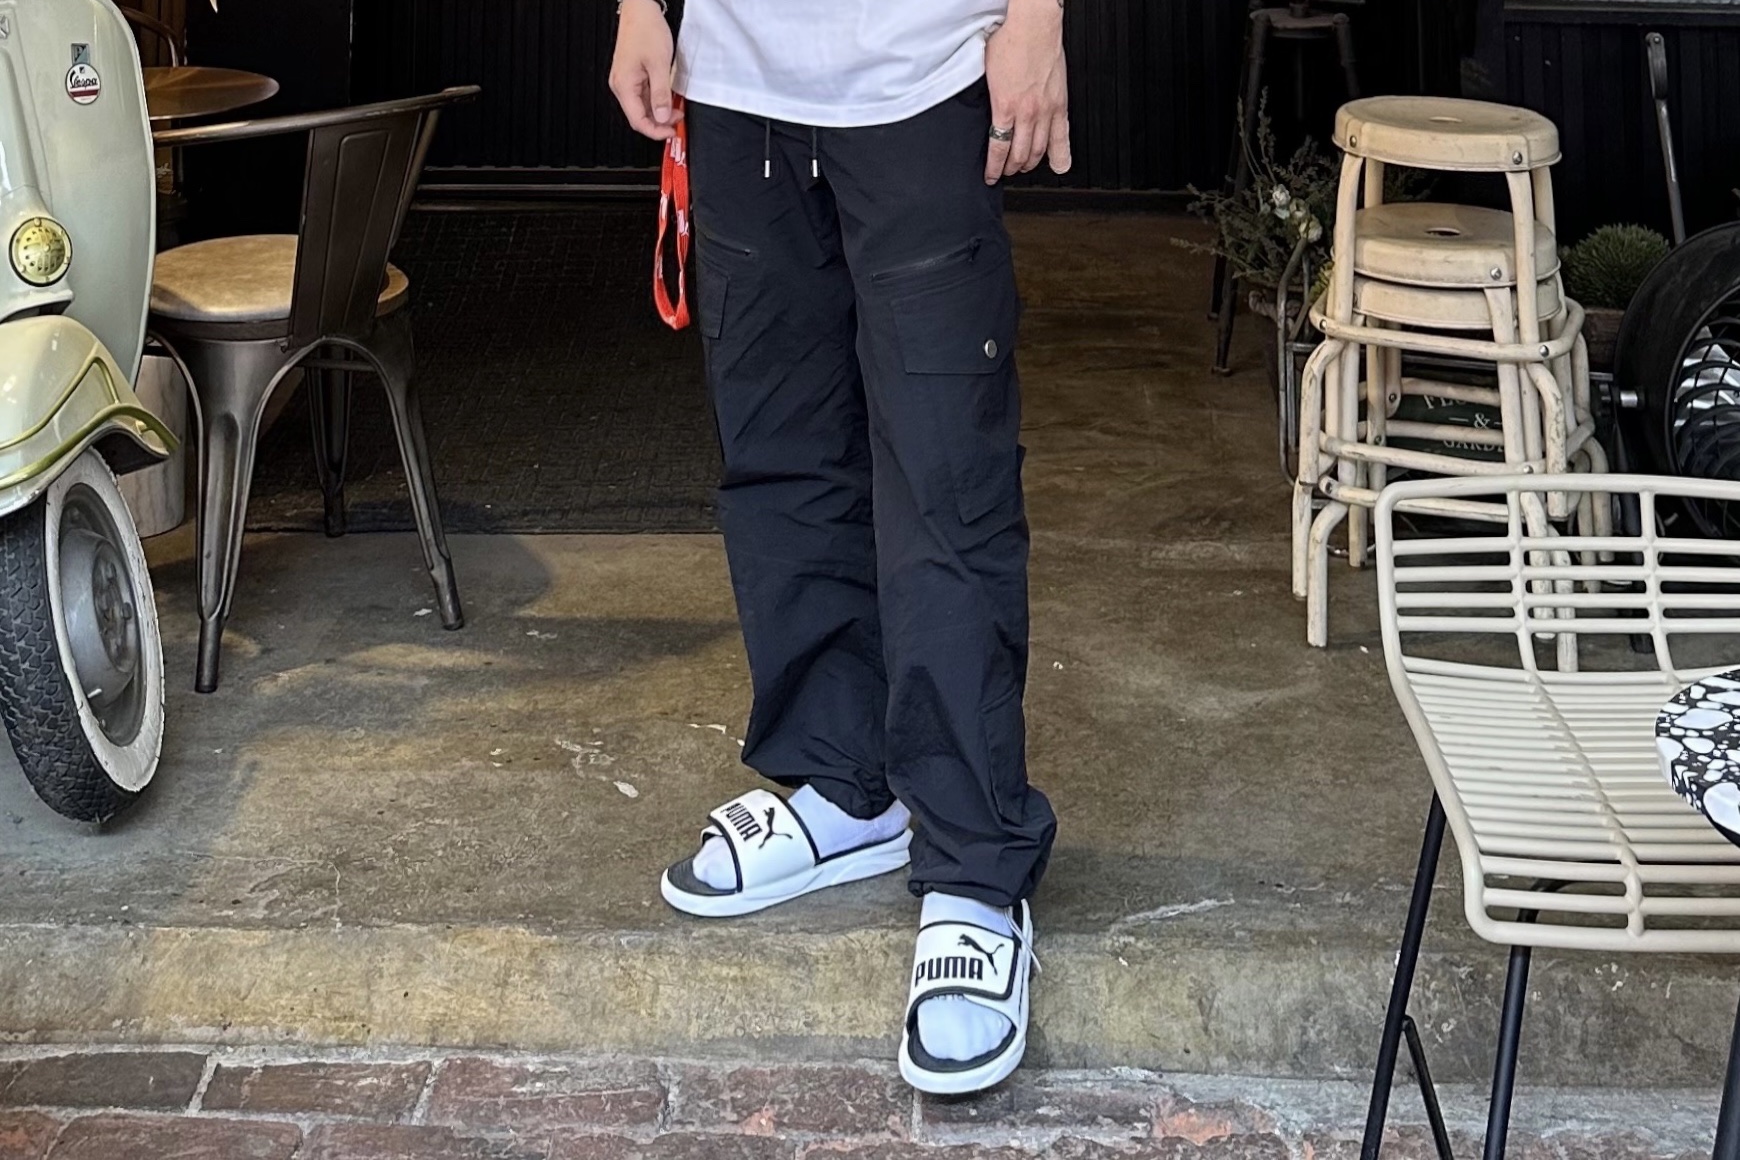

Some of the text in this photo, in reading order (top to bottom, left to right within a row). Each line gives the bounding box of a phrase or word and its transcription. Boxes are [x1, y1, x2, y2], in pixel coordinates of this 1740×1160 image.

[69, 70, 98, 90] Vespa
[720, 802, 763, 842] PUMA
[915, 956, 983, 988] PUMA
